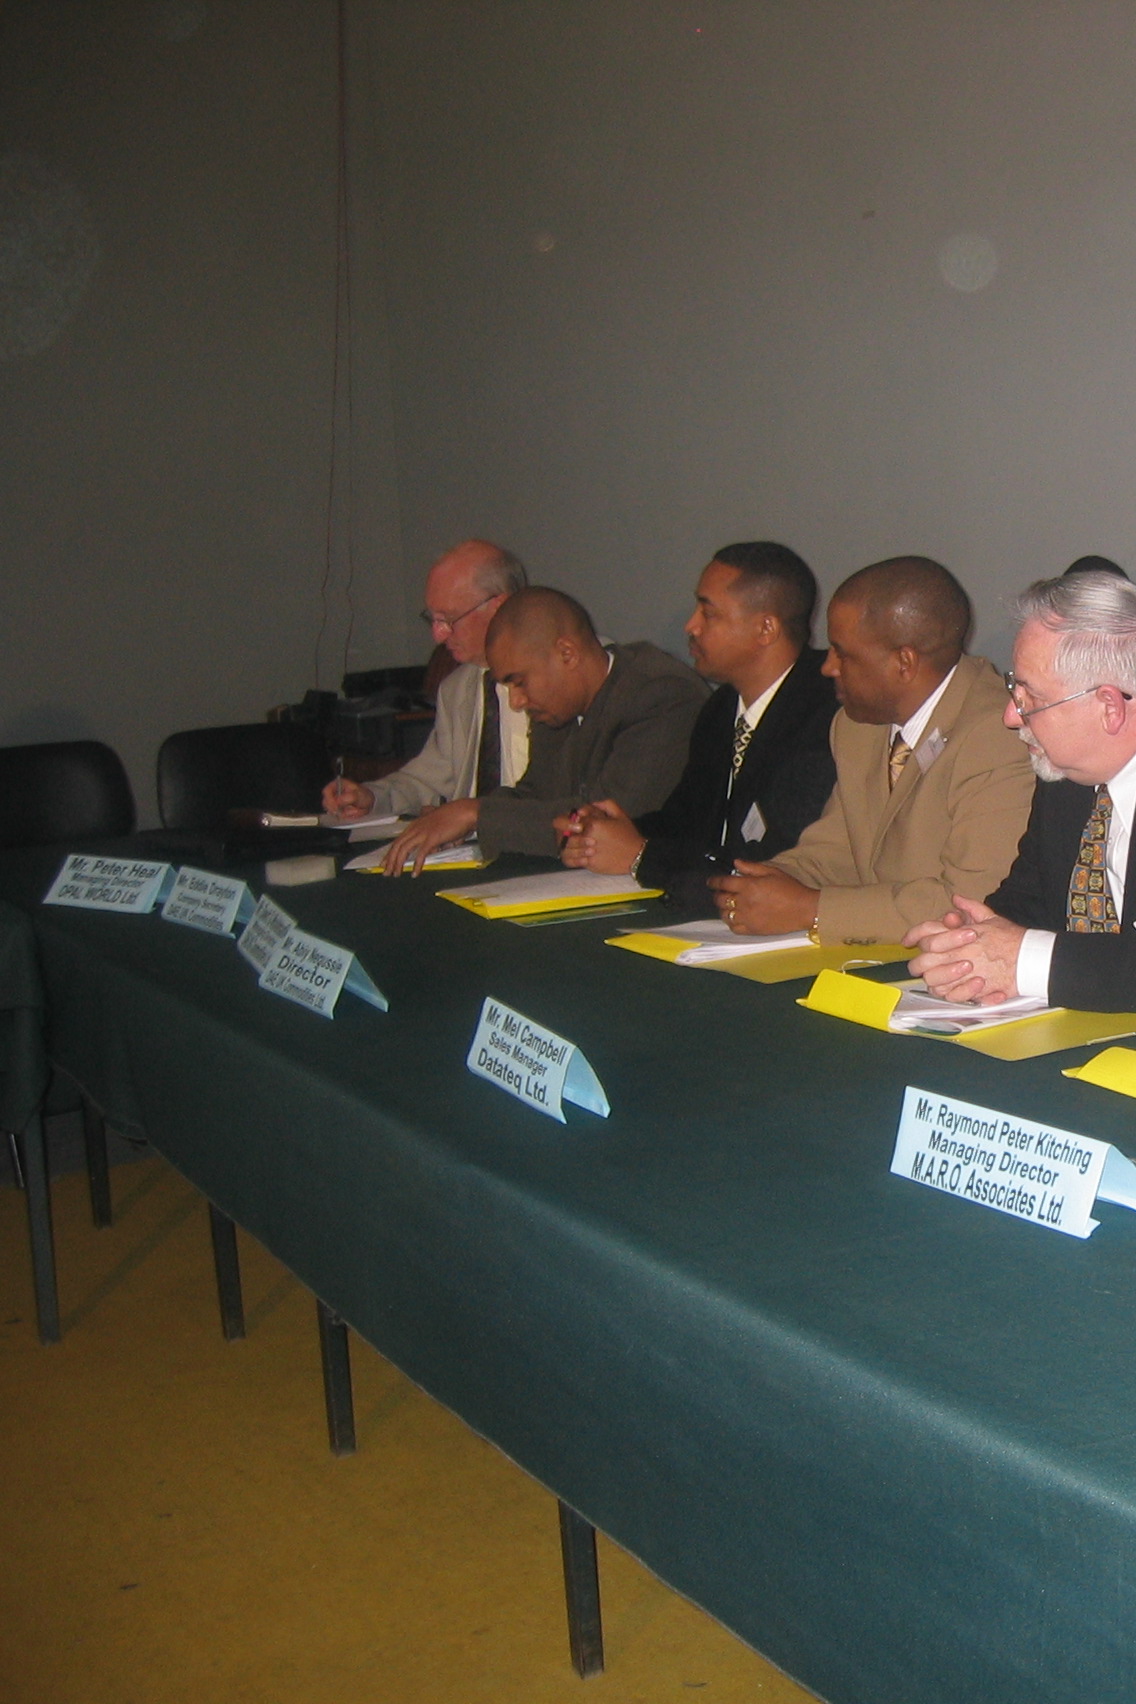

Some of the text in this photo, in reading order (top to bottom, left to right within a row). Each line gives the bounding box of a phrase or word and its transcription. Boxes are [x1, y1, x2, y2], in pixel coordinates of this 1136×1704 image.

[92, 860, 128, 875] Peter
[129, 865, 162, 878] Heal
[110, 877, 145, 887] Director
[84, 887, 122, 903] WORLD
[278, 956, 330, 989] Director
[486, 1005, 568, 1065] Mr. Mel Campbell
[489, 1032, 548, 1077] Sales Manager
[478, 1049, 550, 1106] Datateq Ltd.
[915, 1098, 1093, 1175] Mr. Raymond Peter Kitching
[928, 1130, 1060, 1187] Managing Director
[911, 1151, 1065, 1225] M.A.R.O. Associates Ltd.
